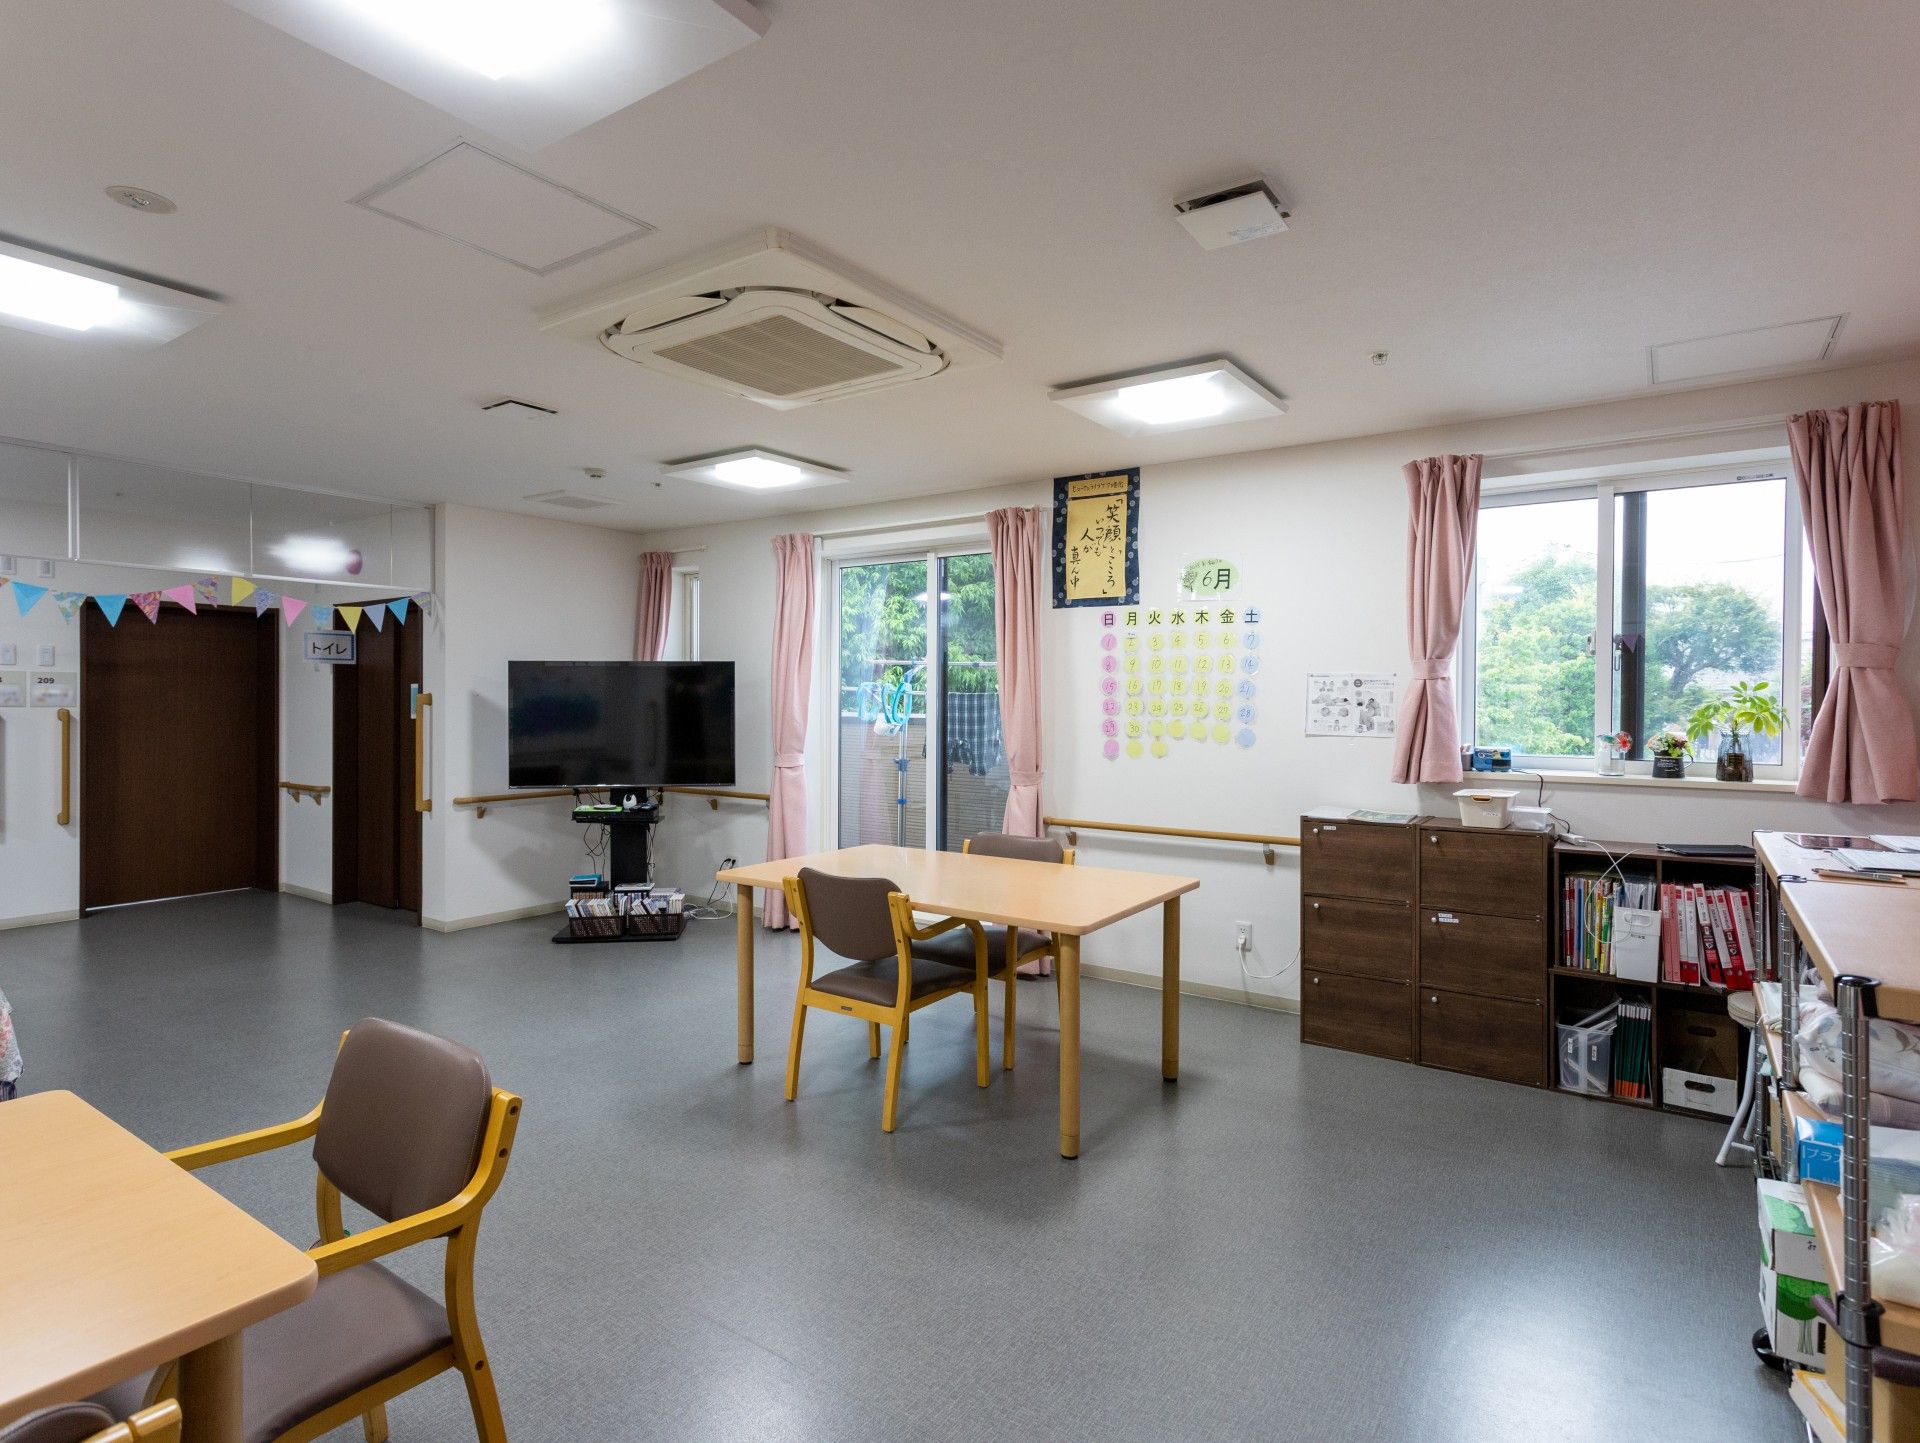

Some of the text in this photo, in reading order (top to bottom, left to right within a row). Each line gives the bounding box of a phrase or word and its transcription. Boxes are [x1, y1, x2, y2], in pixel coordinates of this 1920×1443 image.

[1080, 528, 1095, 553] 人が
[1095, 518, 1104, 557] いつでも
[1070, 546, 1081, 589] 真ん中
[1202, 568, 1231, 590] 6月
[1104, 608, 1259, 626] 日 月 火 水 木 金 土
[1198, 634, 1205, 645] 5
[1223, 632, 1230, 645] 6
[312, 641, 348, 655] トイレ
[1129, 658, 1136, 671] 9
[1151, 659, 1161, 670] 10
[1174, 660, 1182, 669] 11
[1198, 659, 1207, 669] 12
[1221, 659, 1231, 669] 13
[1244, 659, 1255, 669] 14
[1105, 682, 1115, 691] 15
[1128, 680, 1138, 689] 16
[1152, 680, 1162, 691] 17
[1197, 680, 1207, 690] 19
[1219, 683, 1230, 693] 20
[1128, 702, 1138, 711] 23
[1240, 708, 1251, 718] 28
[1130, 724, 1140, 733] 30
